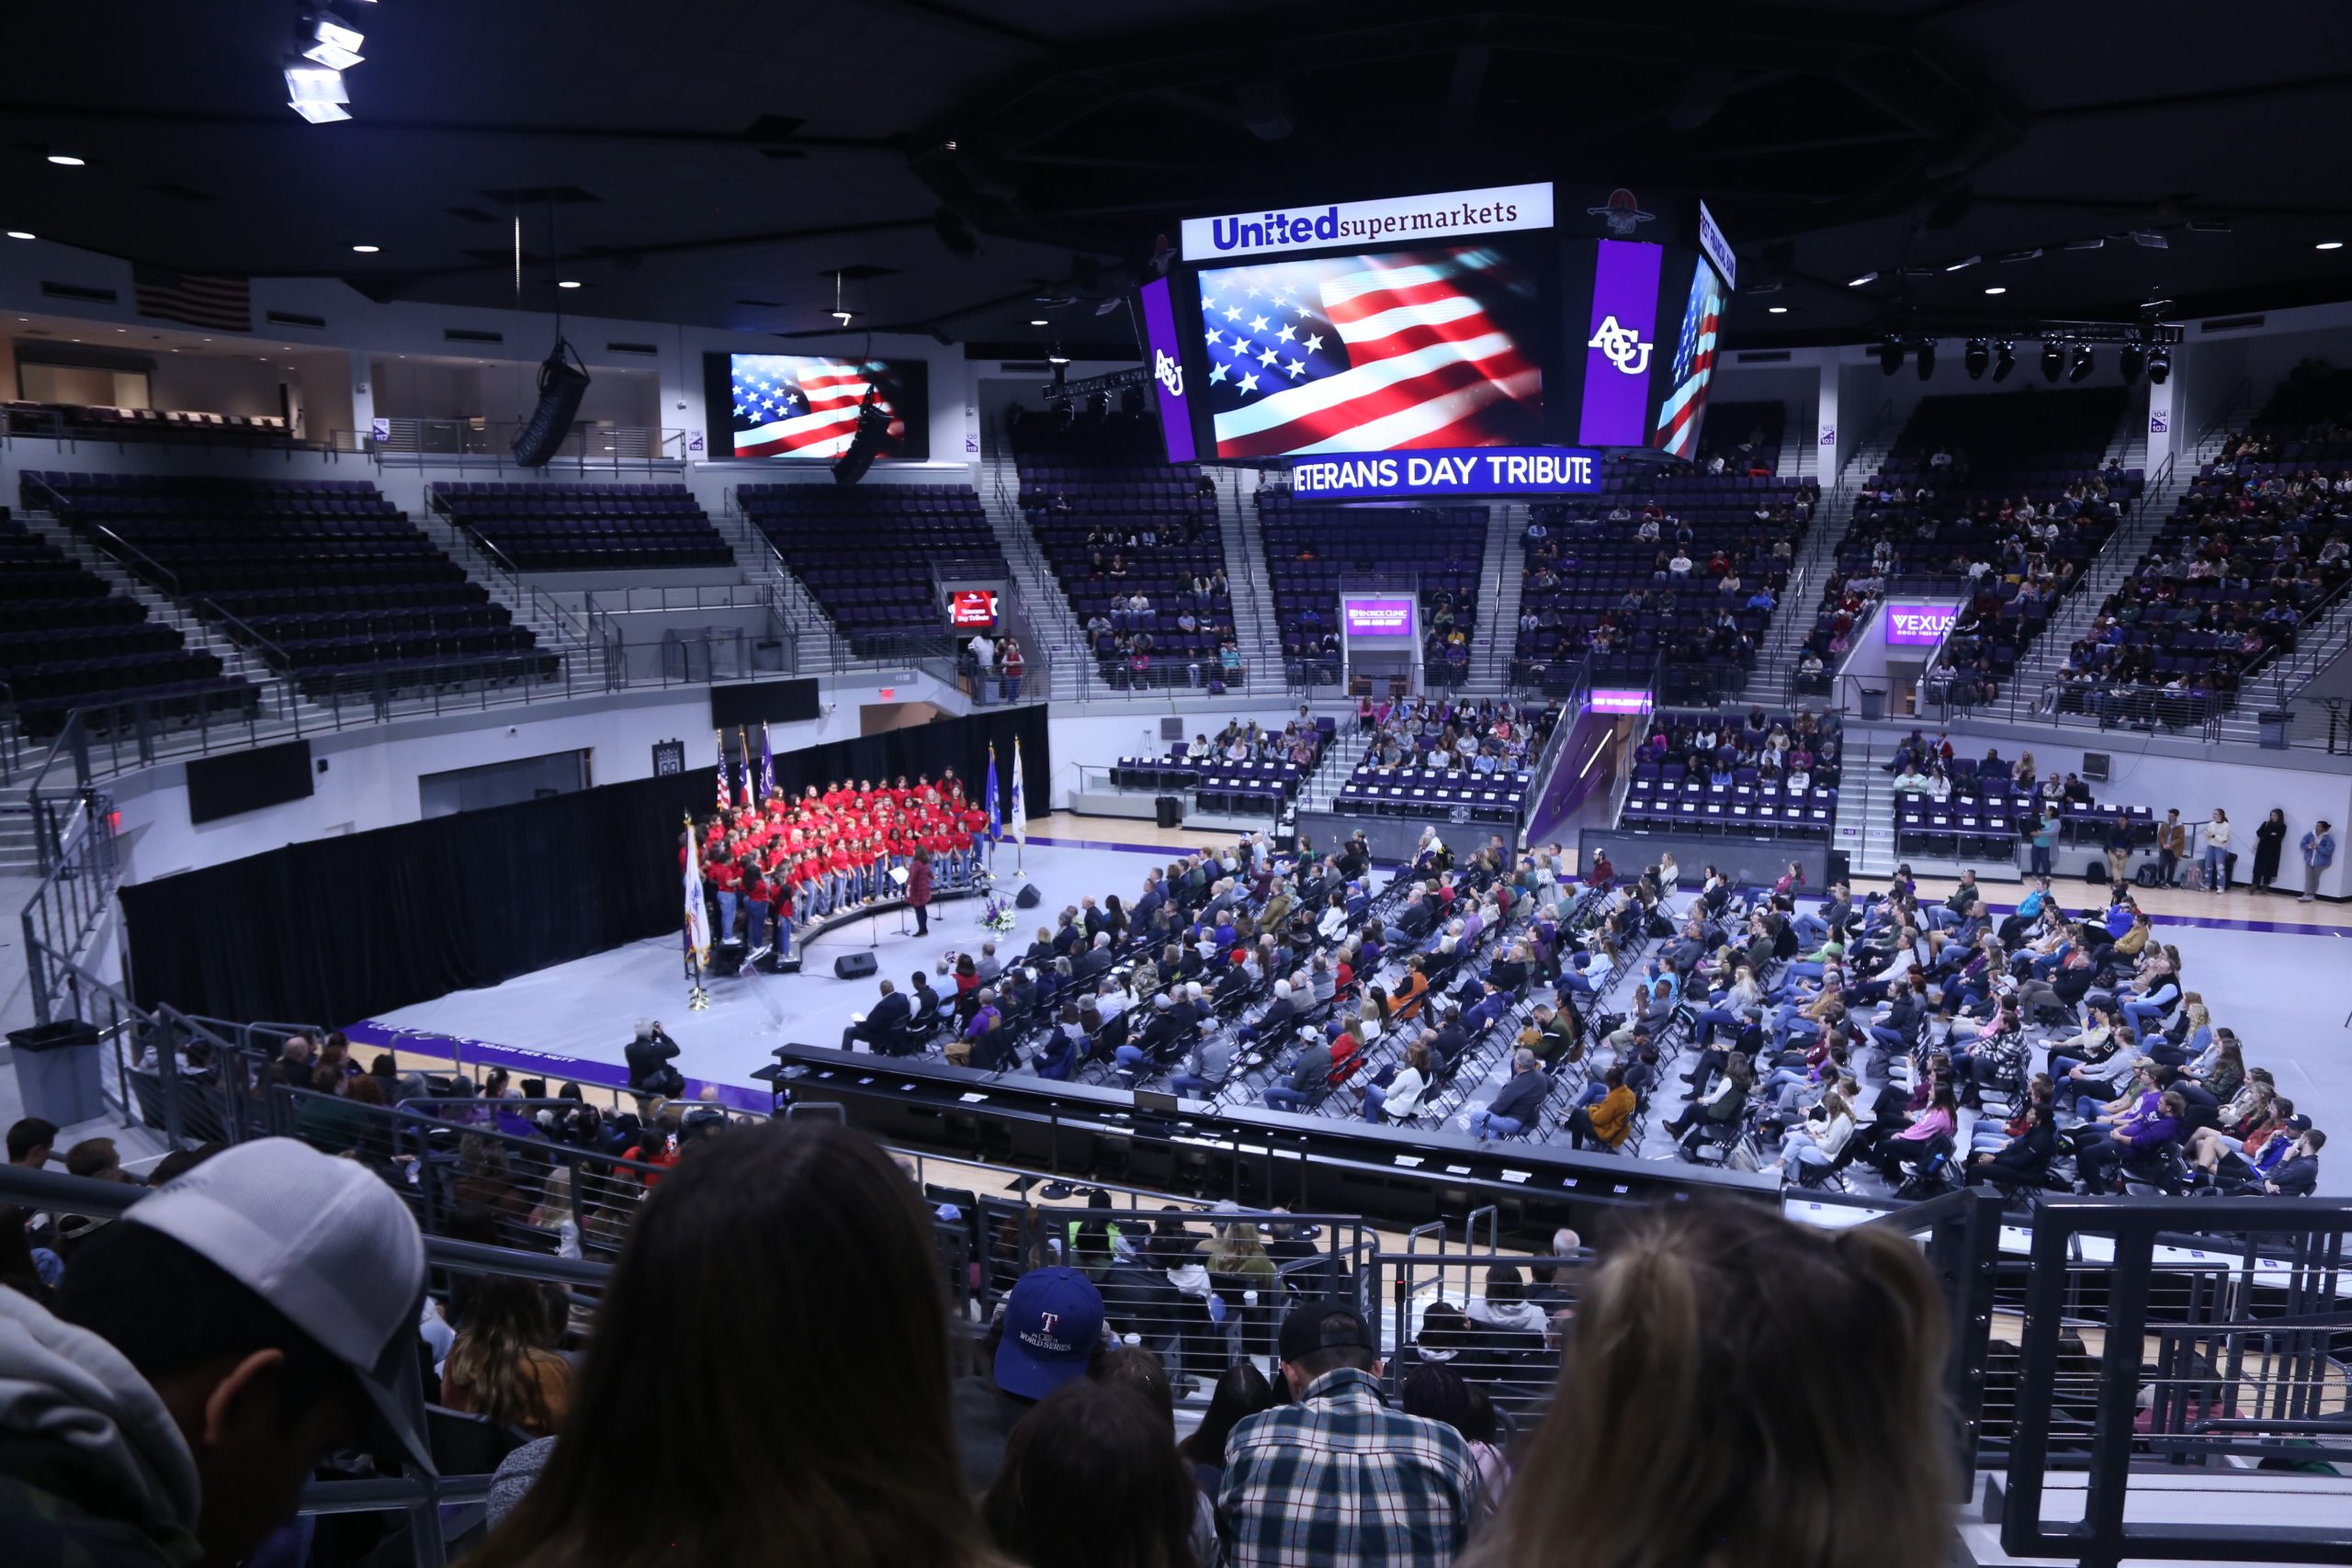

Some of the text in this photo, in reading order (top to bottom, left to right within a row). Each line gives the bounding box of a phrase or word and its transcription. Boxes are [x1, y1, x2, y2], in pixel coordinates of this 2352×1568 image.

[1212, 201, 1518, 251] United supermarkets
[1293, 456, 1592, 491] VETERANS DAY TRIBUTE
[1892, 615, 1956, 630] VEXUS
[1041, 1312, 1058, 1332] T
[1020, 1330, 1071, 1351] WORLD SERIES
